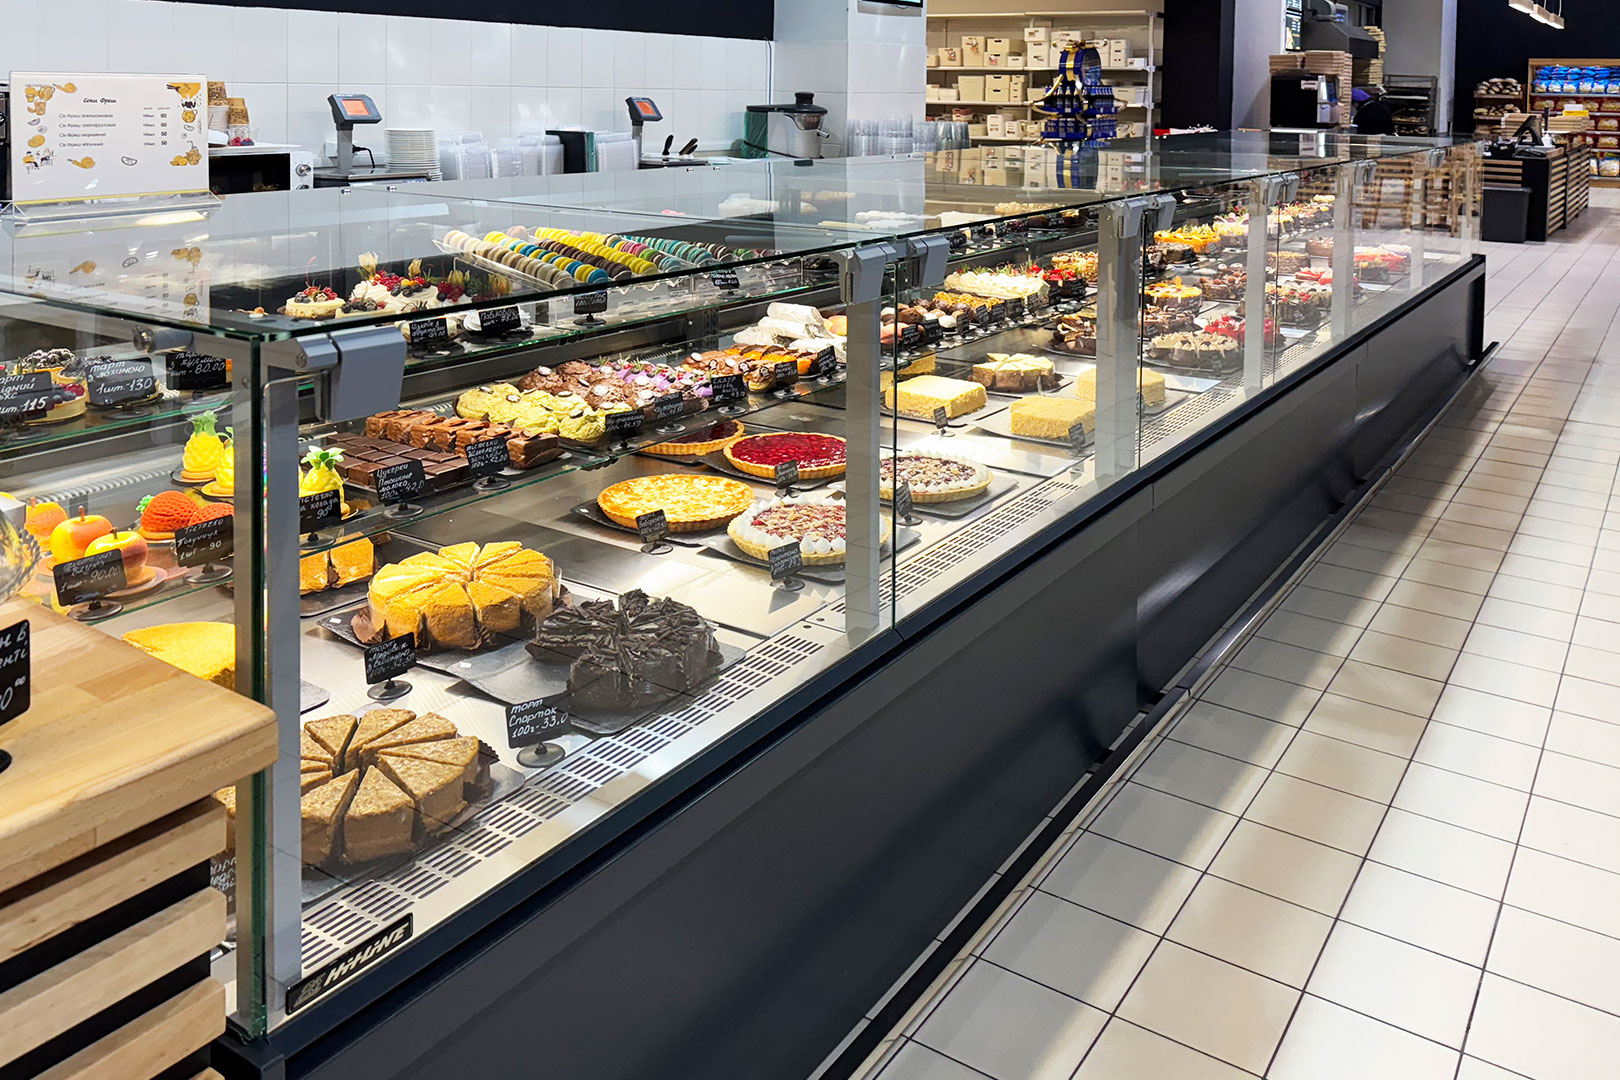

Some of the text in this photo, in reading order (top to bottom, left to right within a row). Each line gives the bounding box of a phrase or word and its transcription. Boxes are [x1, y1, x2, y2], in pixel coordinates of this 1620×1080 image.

[89, 361, 126, 373] тарт
[376, 463, 409, 479] Цукерки
[300, 491, 334, 504] істечко
[511, 699, 543, 715] торт
